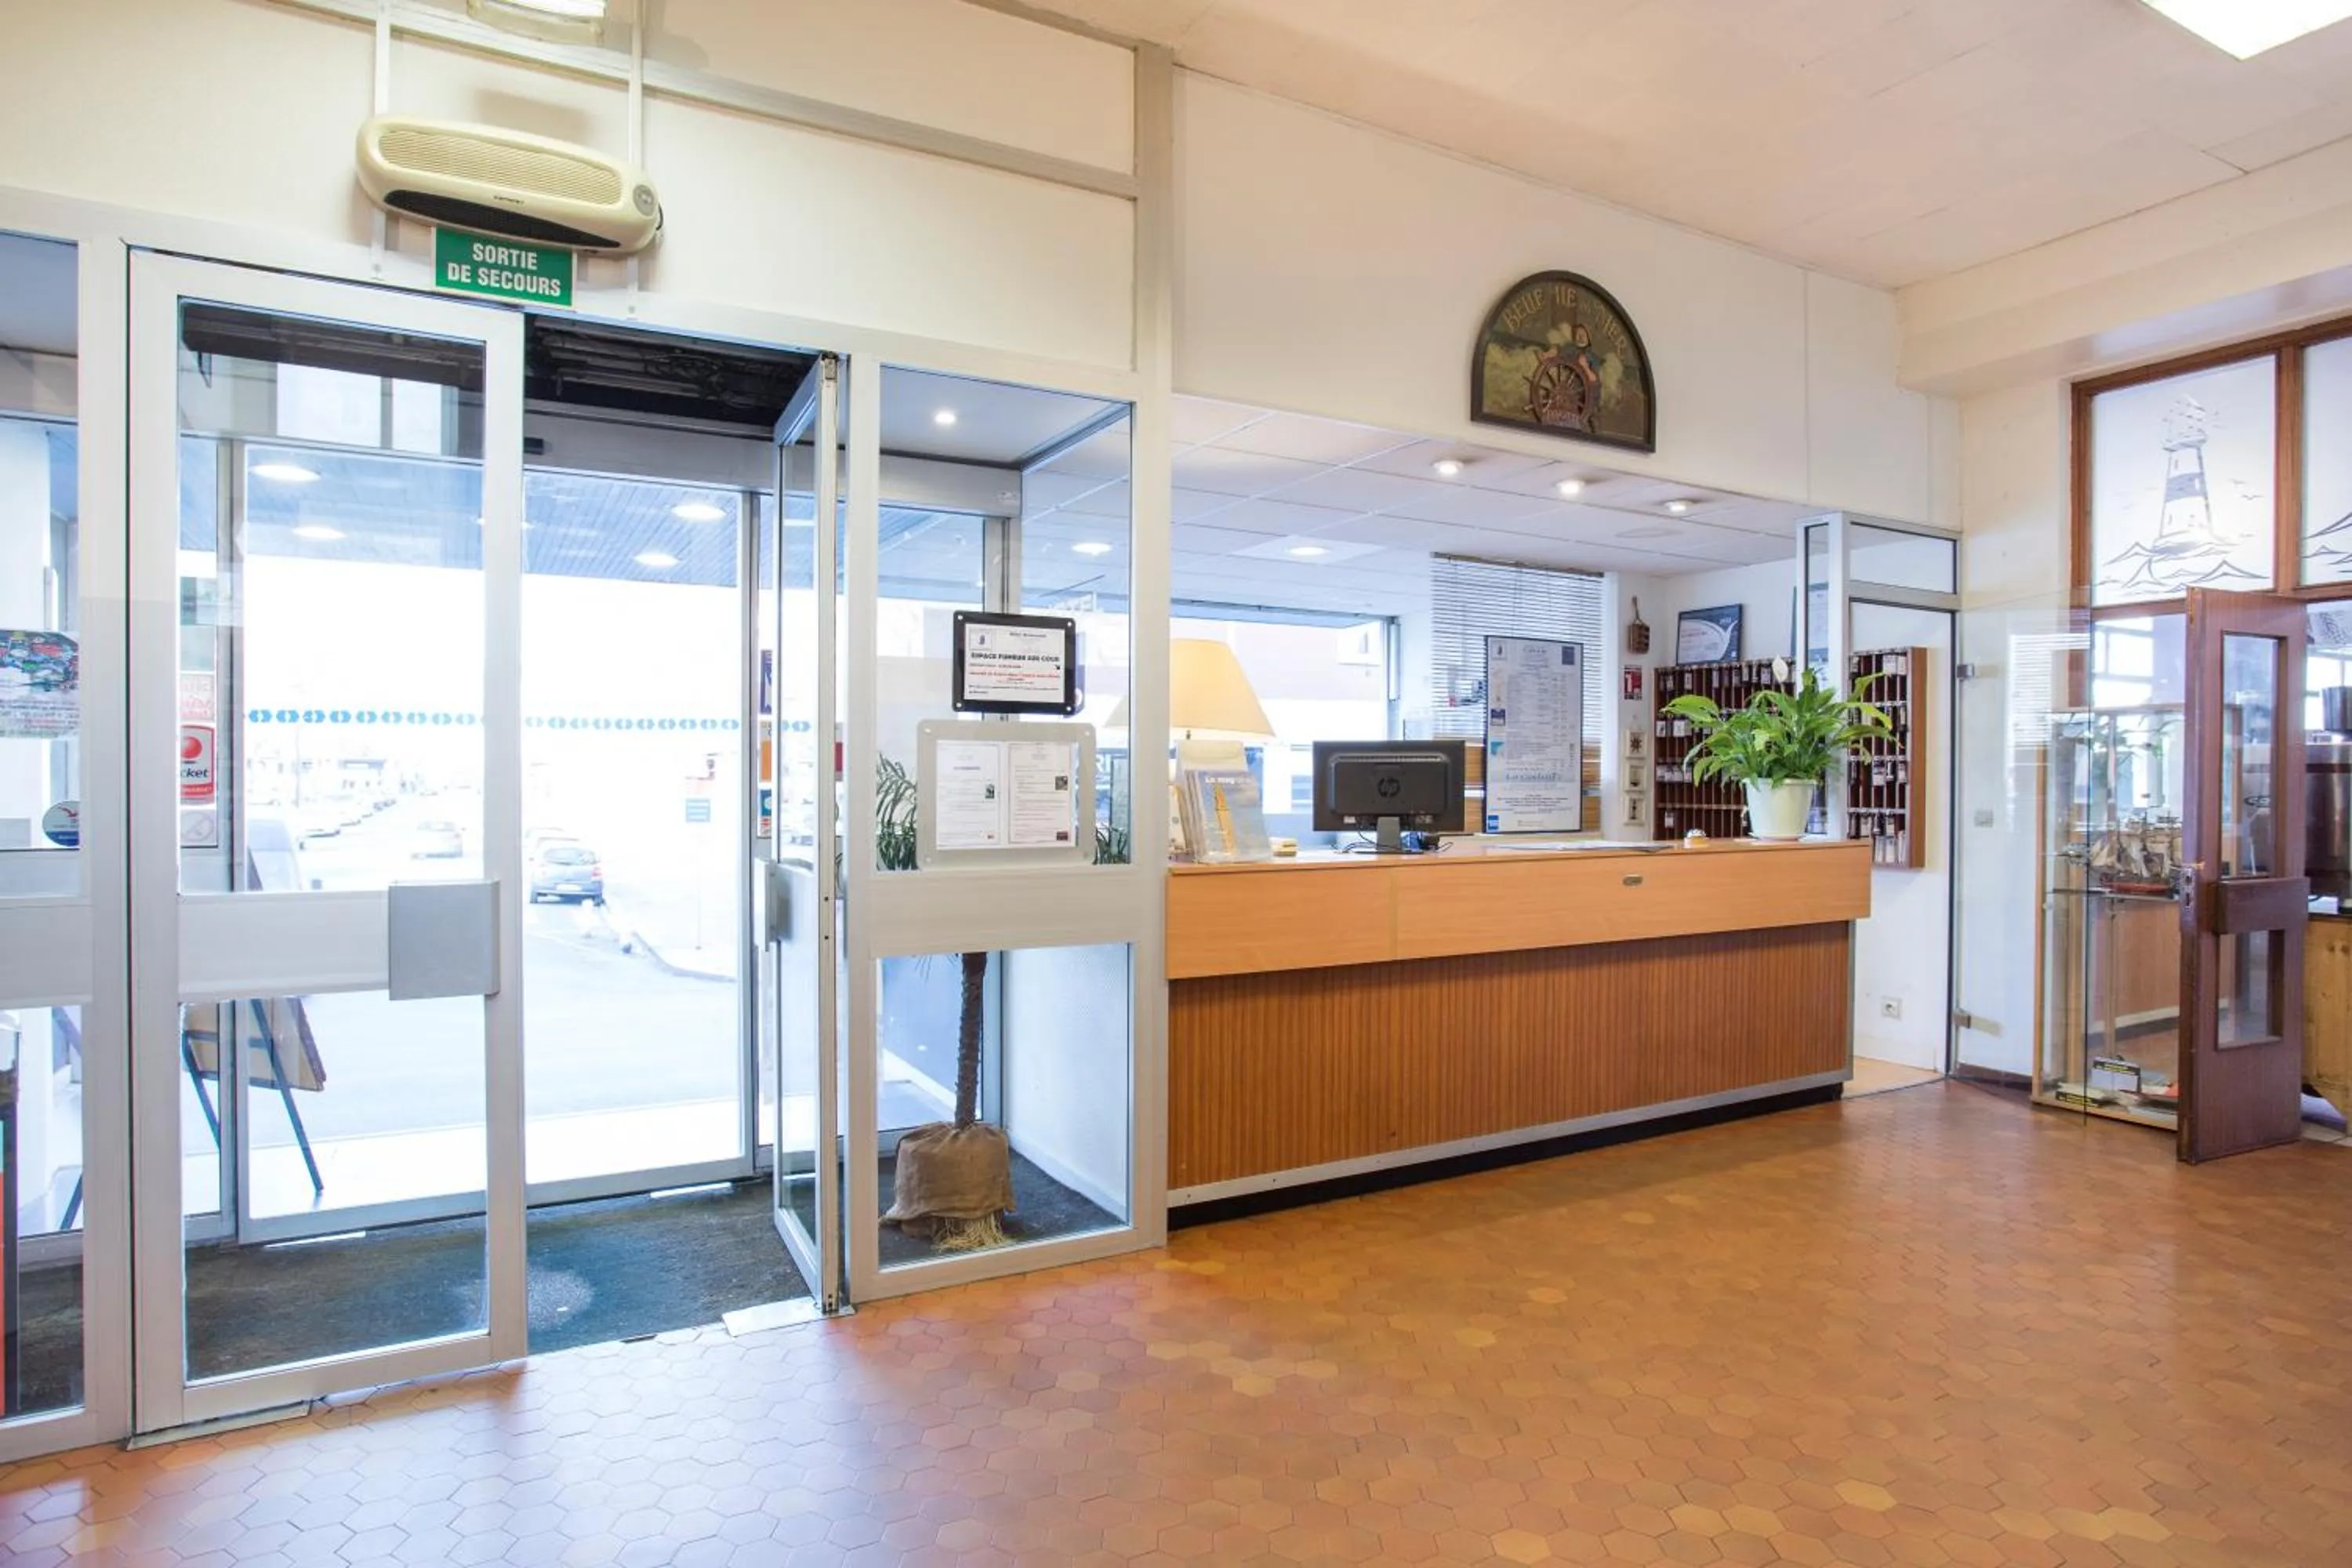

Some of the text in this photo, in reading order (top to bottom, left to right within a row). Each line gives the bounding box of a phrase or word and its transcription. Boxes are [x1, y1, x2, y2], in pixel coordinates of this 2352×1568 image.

[472, 242, 538, 270] SORTIE
[448, 262, 561, 296] DE SECOURS
